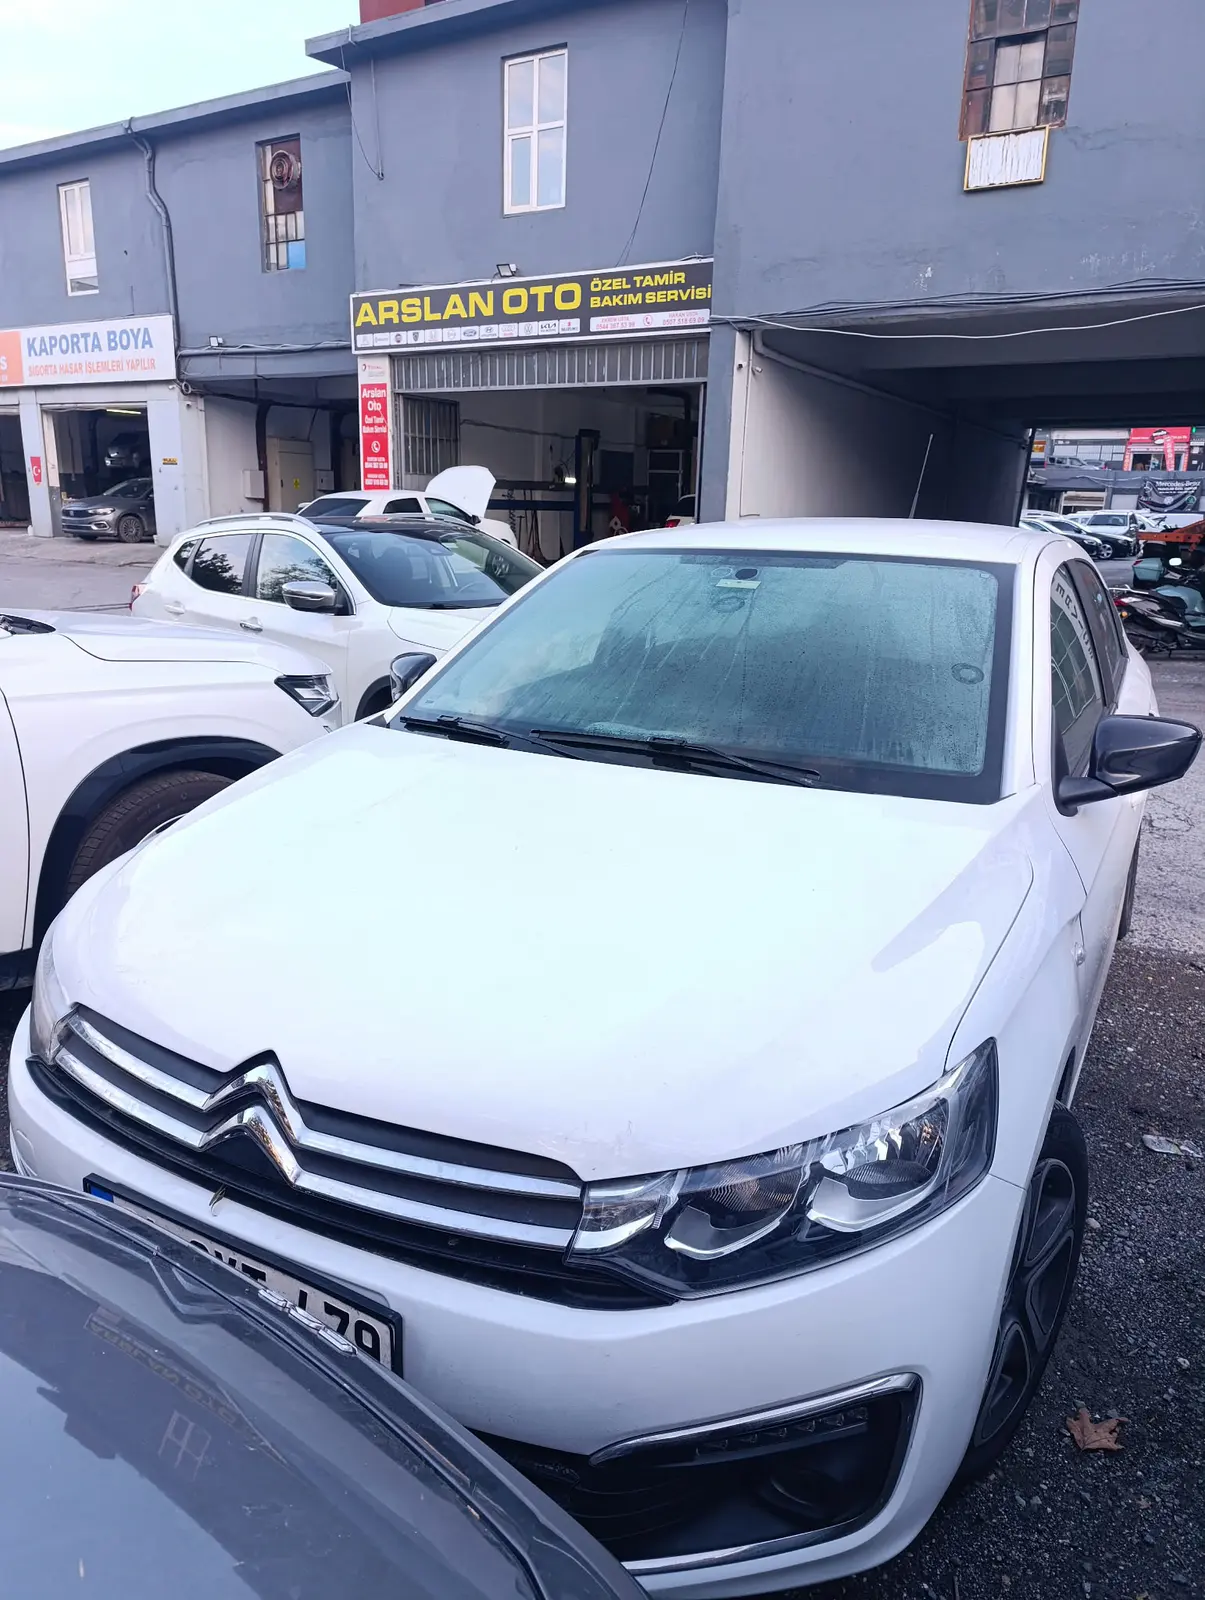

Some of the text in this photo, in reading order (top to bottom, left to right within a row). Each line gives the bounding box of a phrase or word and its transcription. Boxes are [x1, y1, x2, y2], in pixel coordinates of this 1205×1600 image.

[590, 270, 686, 292] ÖZEL TAMİR
[355, 282, 582, 327] ARSLAN OTO
[590, 284, 711, 309] BAKIM SERVİSİ
[27, 327, 154, 357] KAPORTA BOYA
[59, 362, 83, 375] HASAR
[125, 358, 156, 371] YAPILIR
[362, 388, 386, 398] Arslan
[367, 400, 382, 411] Oto
